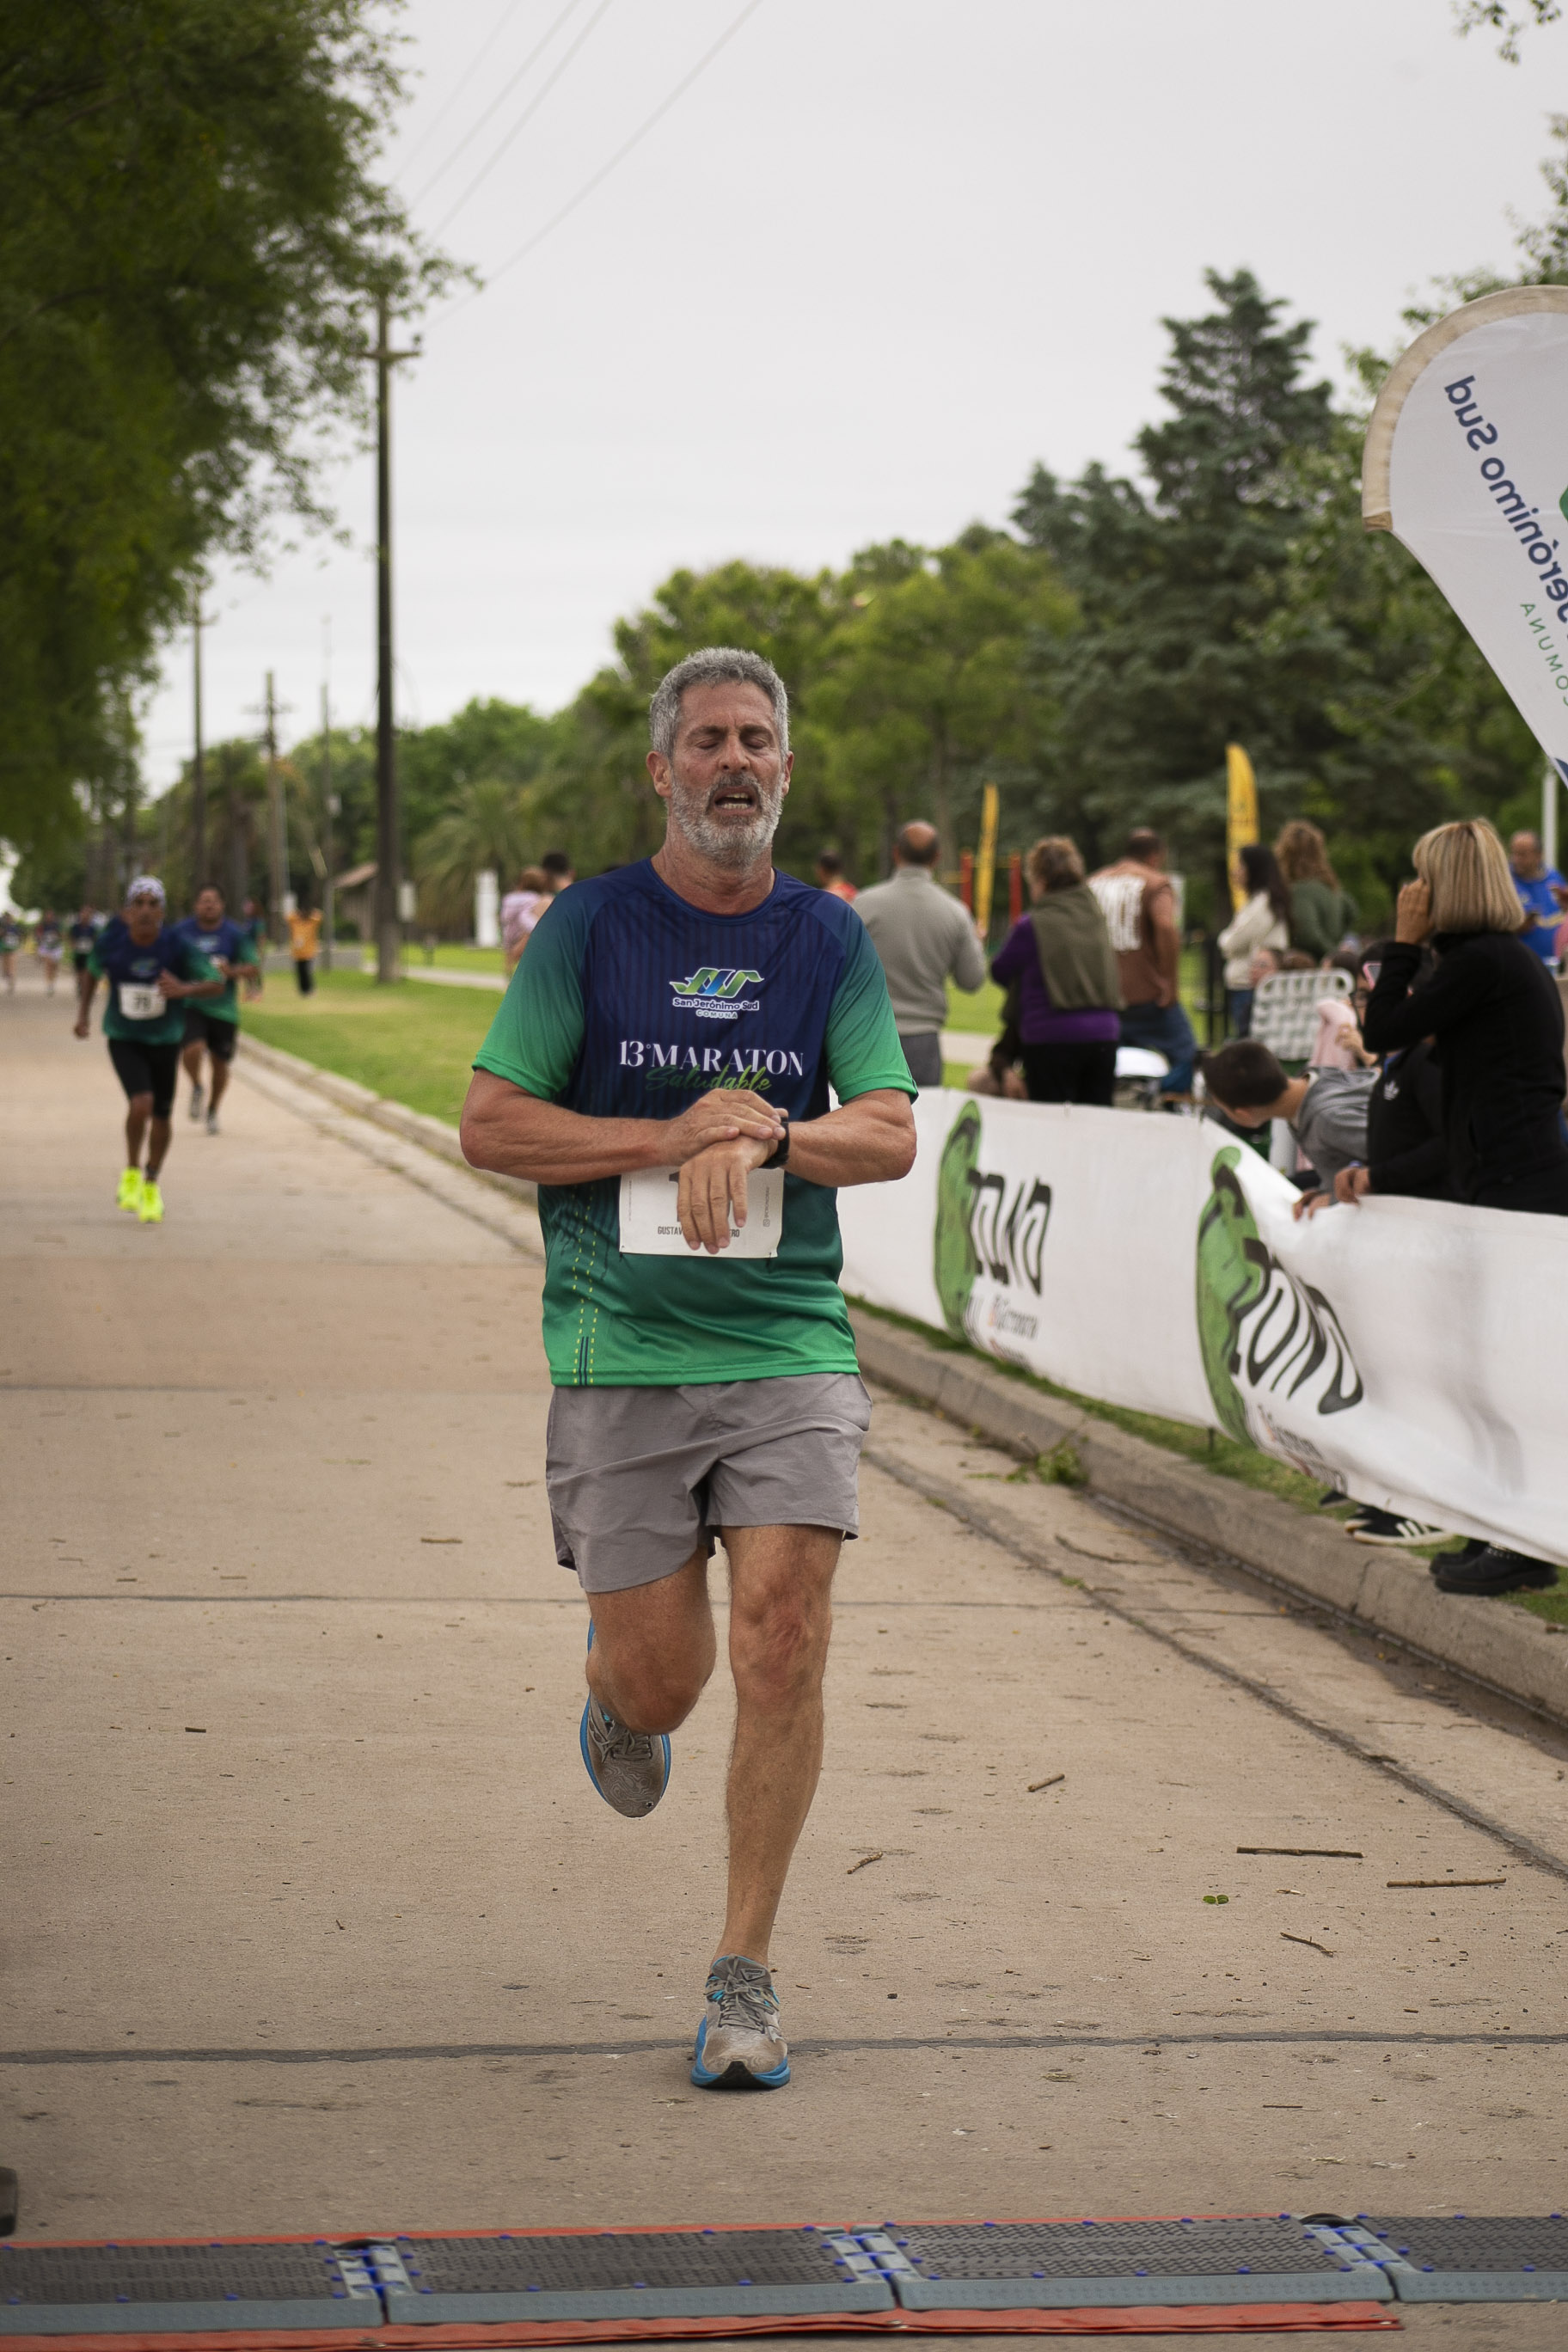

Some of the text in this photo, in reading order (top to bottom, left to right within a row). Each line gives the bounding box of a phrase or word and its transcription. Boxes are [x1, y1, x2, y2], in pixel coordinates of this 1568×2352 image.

[673, 997, 760, 1011] San Jerónimo Sud
[696, 1009, 738, 1019] COMUNA
[650, 1043, 804, 1076] MARATON
[646, 1063, 772, 1091] Saludable
[658, 1226, 683, 1235] GUSTAV
